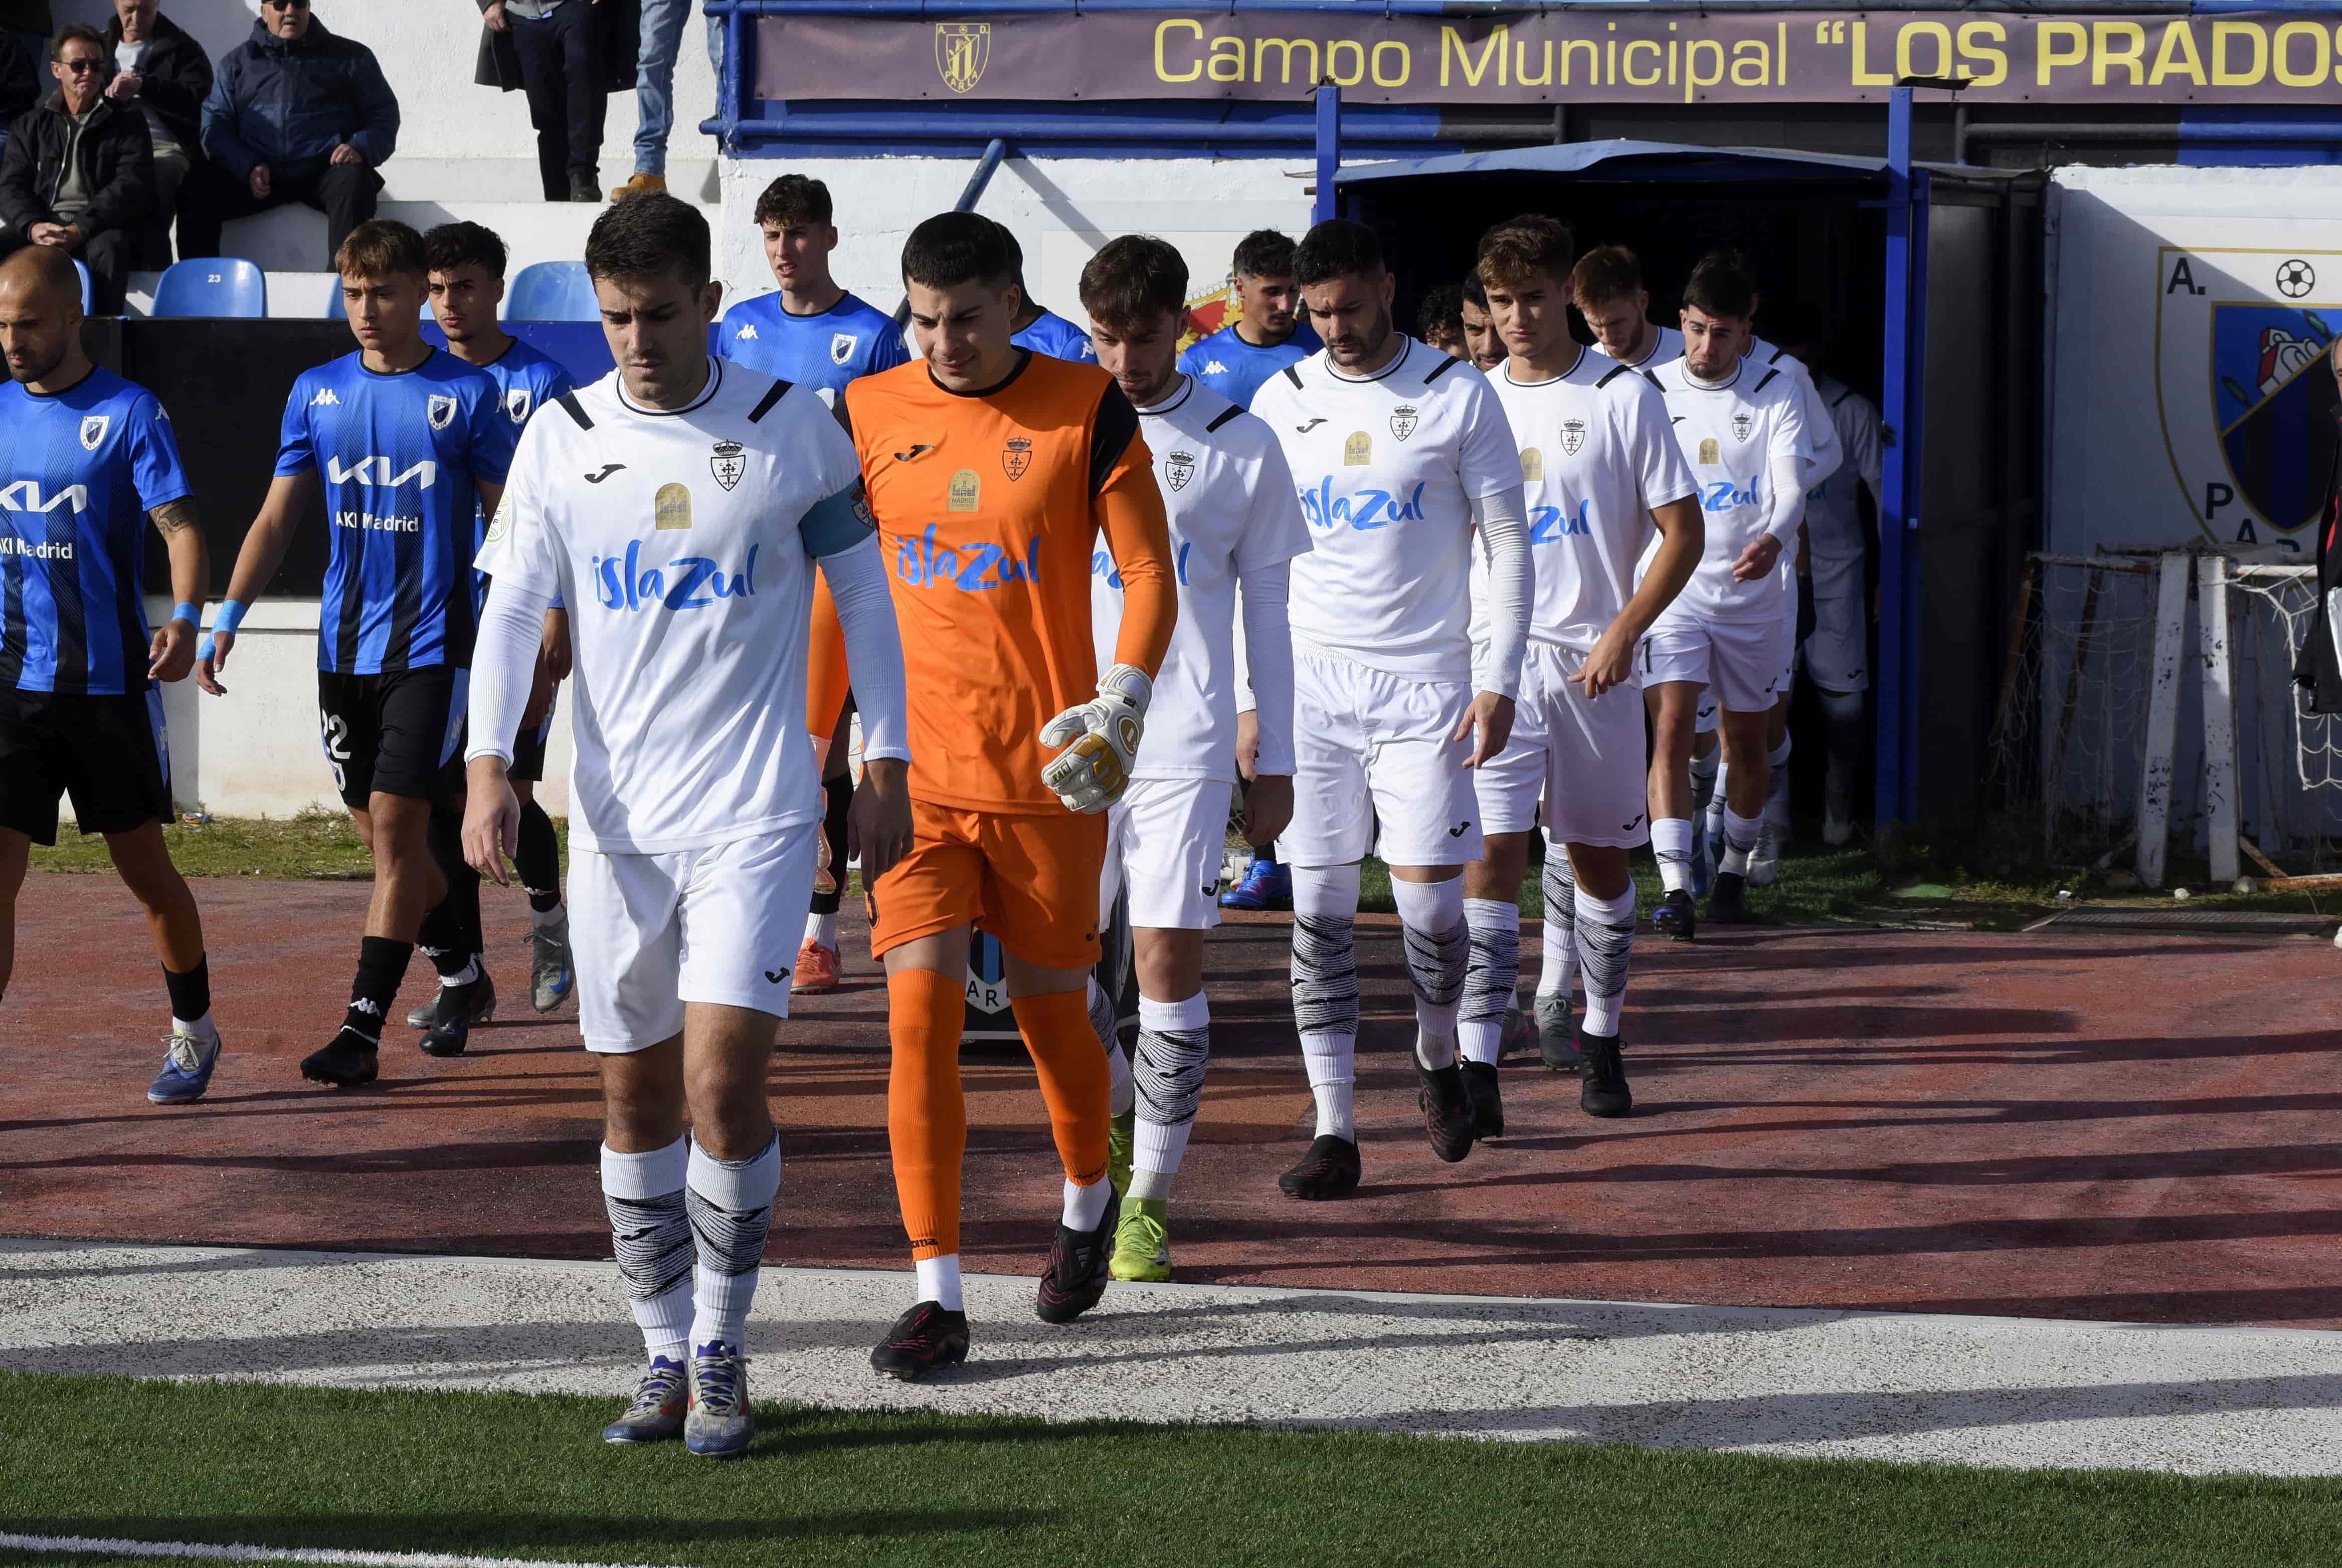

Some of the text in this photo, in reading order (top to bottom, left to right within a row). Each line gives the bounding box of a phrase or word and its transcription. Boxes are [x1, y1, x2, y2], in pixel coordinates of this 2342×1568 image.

[1155, 19, 1410, 86] Campo
[1440, 23, 1786, 103] Municipal
[2092, 21, 2342, 87] PRADO
[945, 71, 979, 90] PARLA
[208, 274, 221, 283] 23
[2167, 257, 2206, 295] A.
[336, 511, 419, 532] AKI Madrid
[966, 980, 1010, 1007] AR
